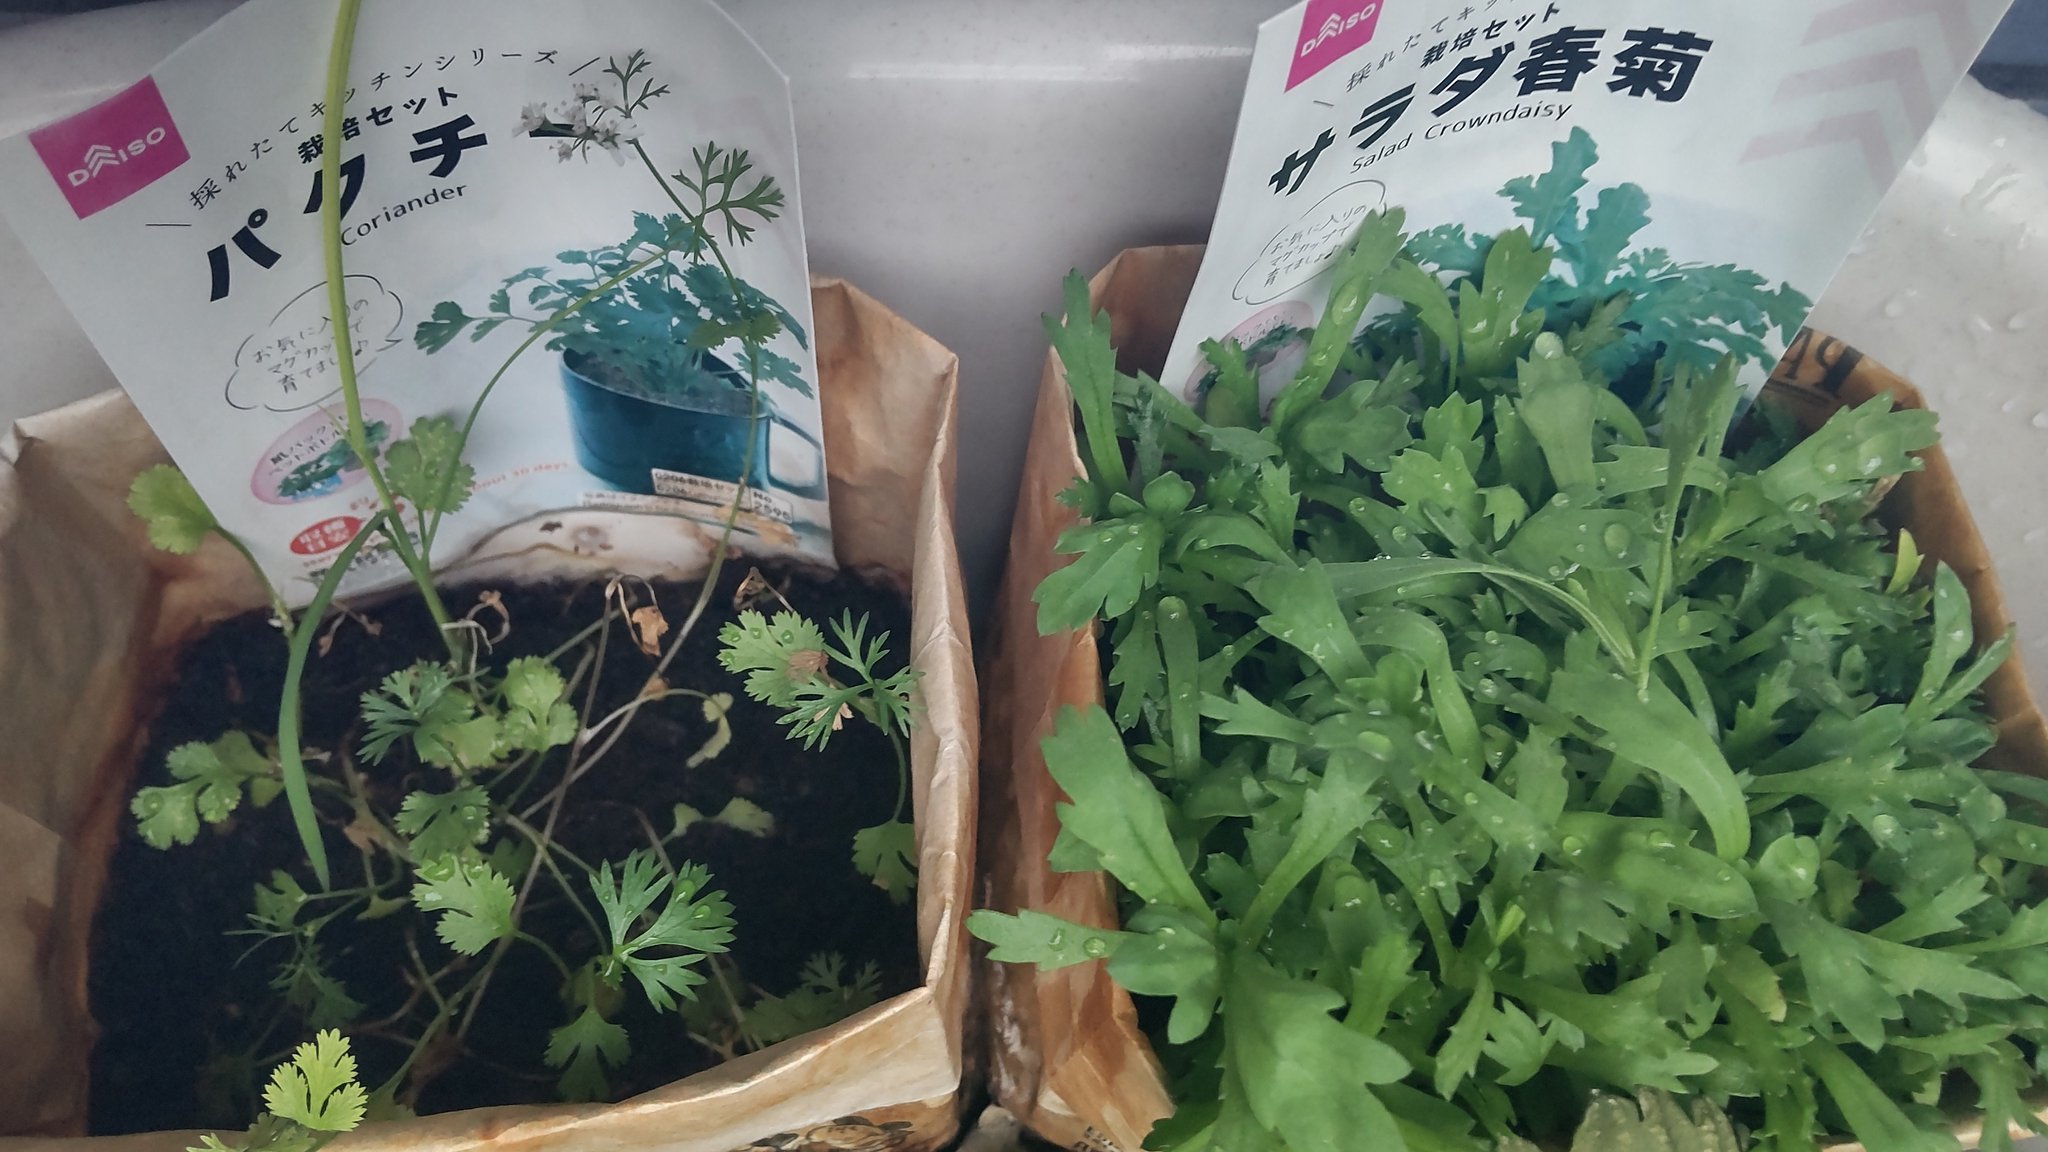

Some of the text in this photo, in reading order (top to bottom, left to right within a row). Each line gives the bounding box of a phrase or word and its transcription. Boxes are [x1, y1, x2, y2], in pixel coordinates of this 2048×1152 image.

[1301, 3, 1377, 58] DAISO
[1420, 2, 1560, 69] 栽培セット
[298, 87, 458, 164] 栽培セット
[1269, 26, 1714, 197] サラダ春菊
[1351, 100, 1574, 174] Salad Crowndaisy
[67, 127, 166, 187] DAISO
[341, 184, 468, 247] Coriander
[267, 316, 363, 374] マグカッで
